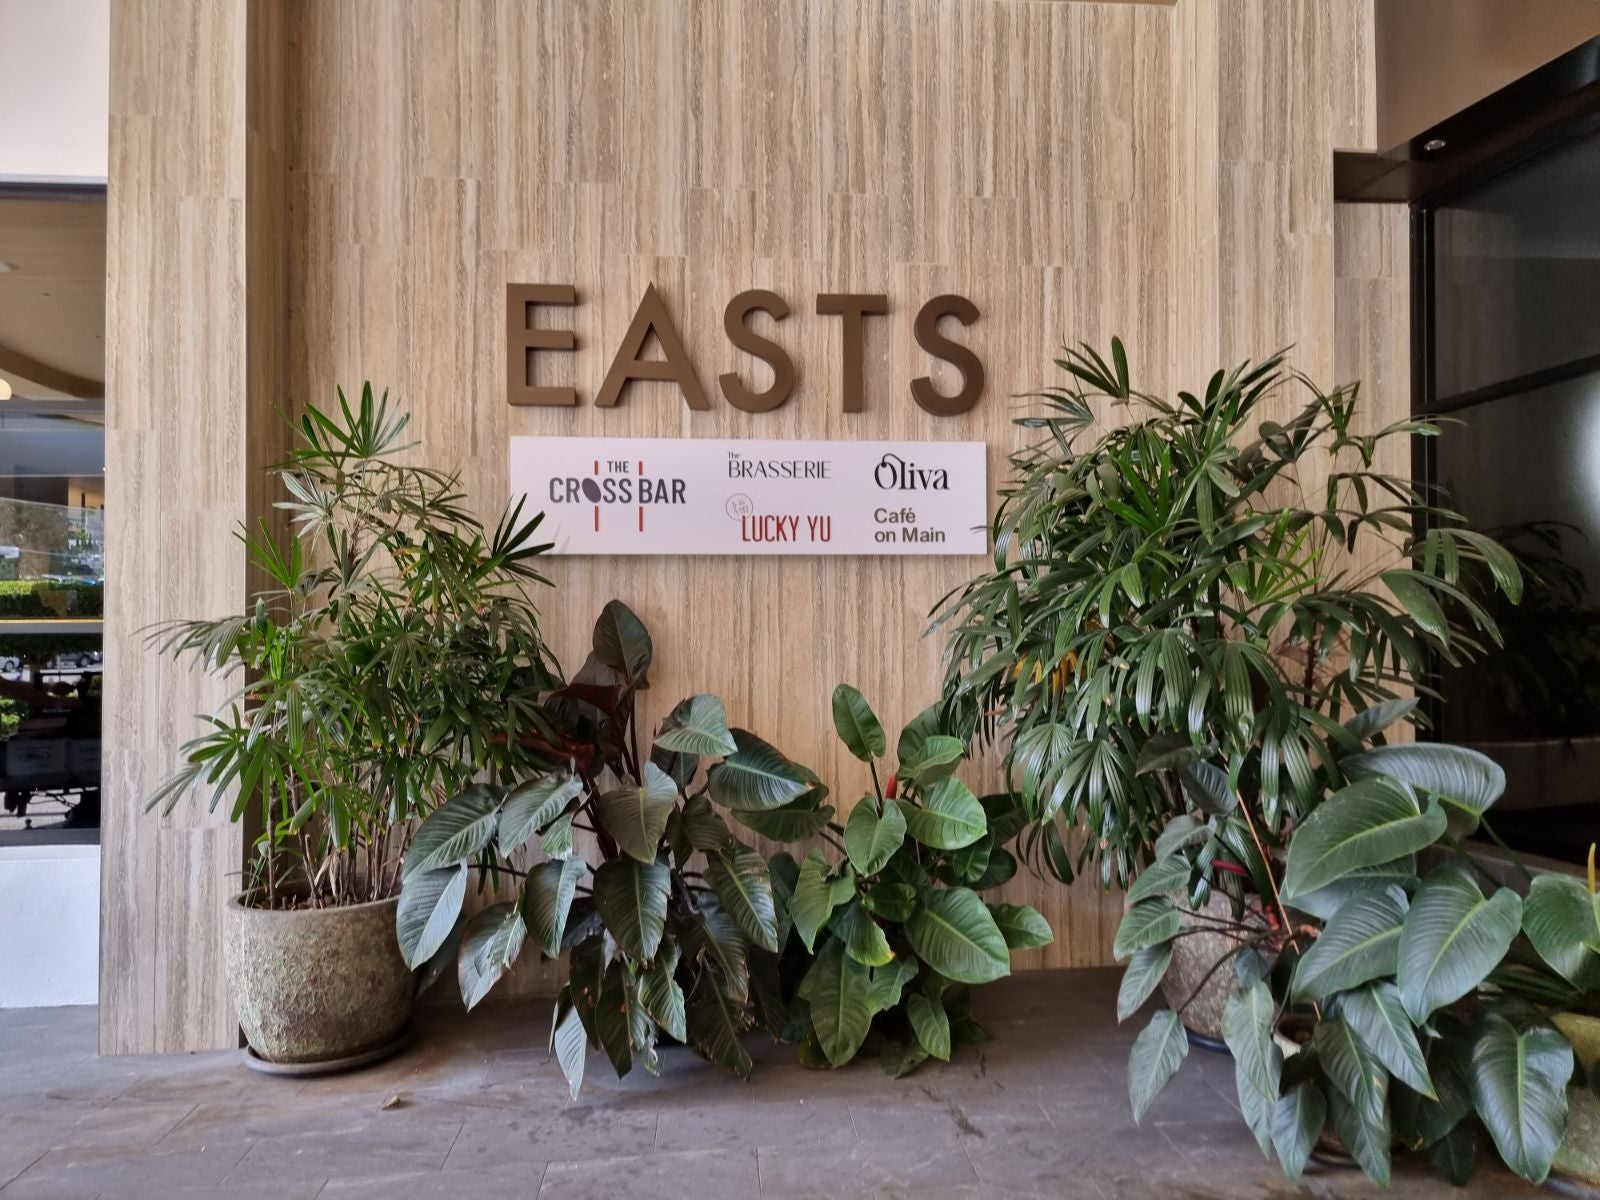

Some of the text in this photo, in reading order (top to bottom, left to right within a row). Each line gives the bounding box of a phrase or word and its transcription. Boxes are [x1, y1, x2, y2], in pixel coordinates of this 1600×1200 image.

[506, 281, 985, 417] EASTS
[607, 461, 629, 473] THE
[728, 460, 832, 479] BRASSERIE
[874, 453, 950, 490] Oliva
[874, 507, 916, 524] Café
[742, 515, 831, 542] LUCKY YU
[874, 527, 946, 543] on Main
